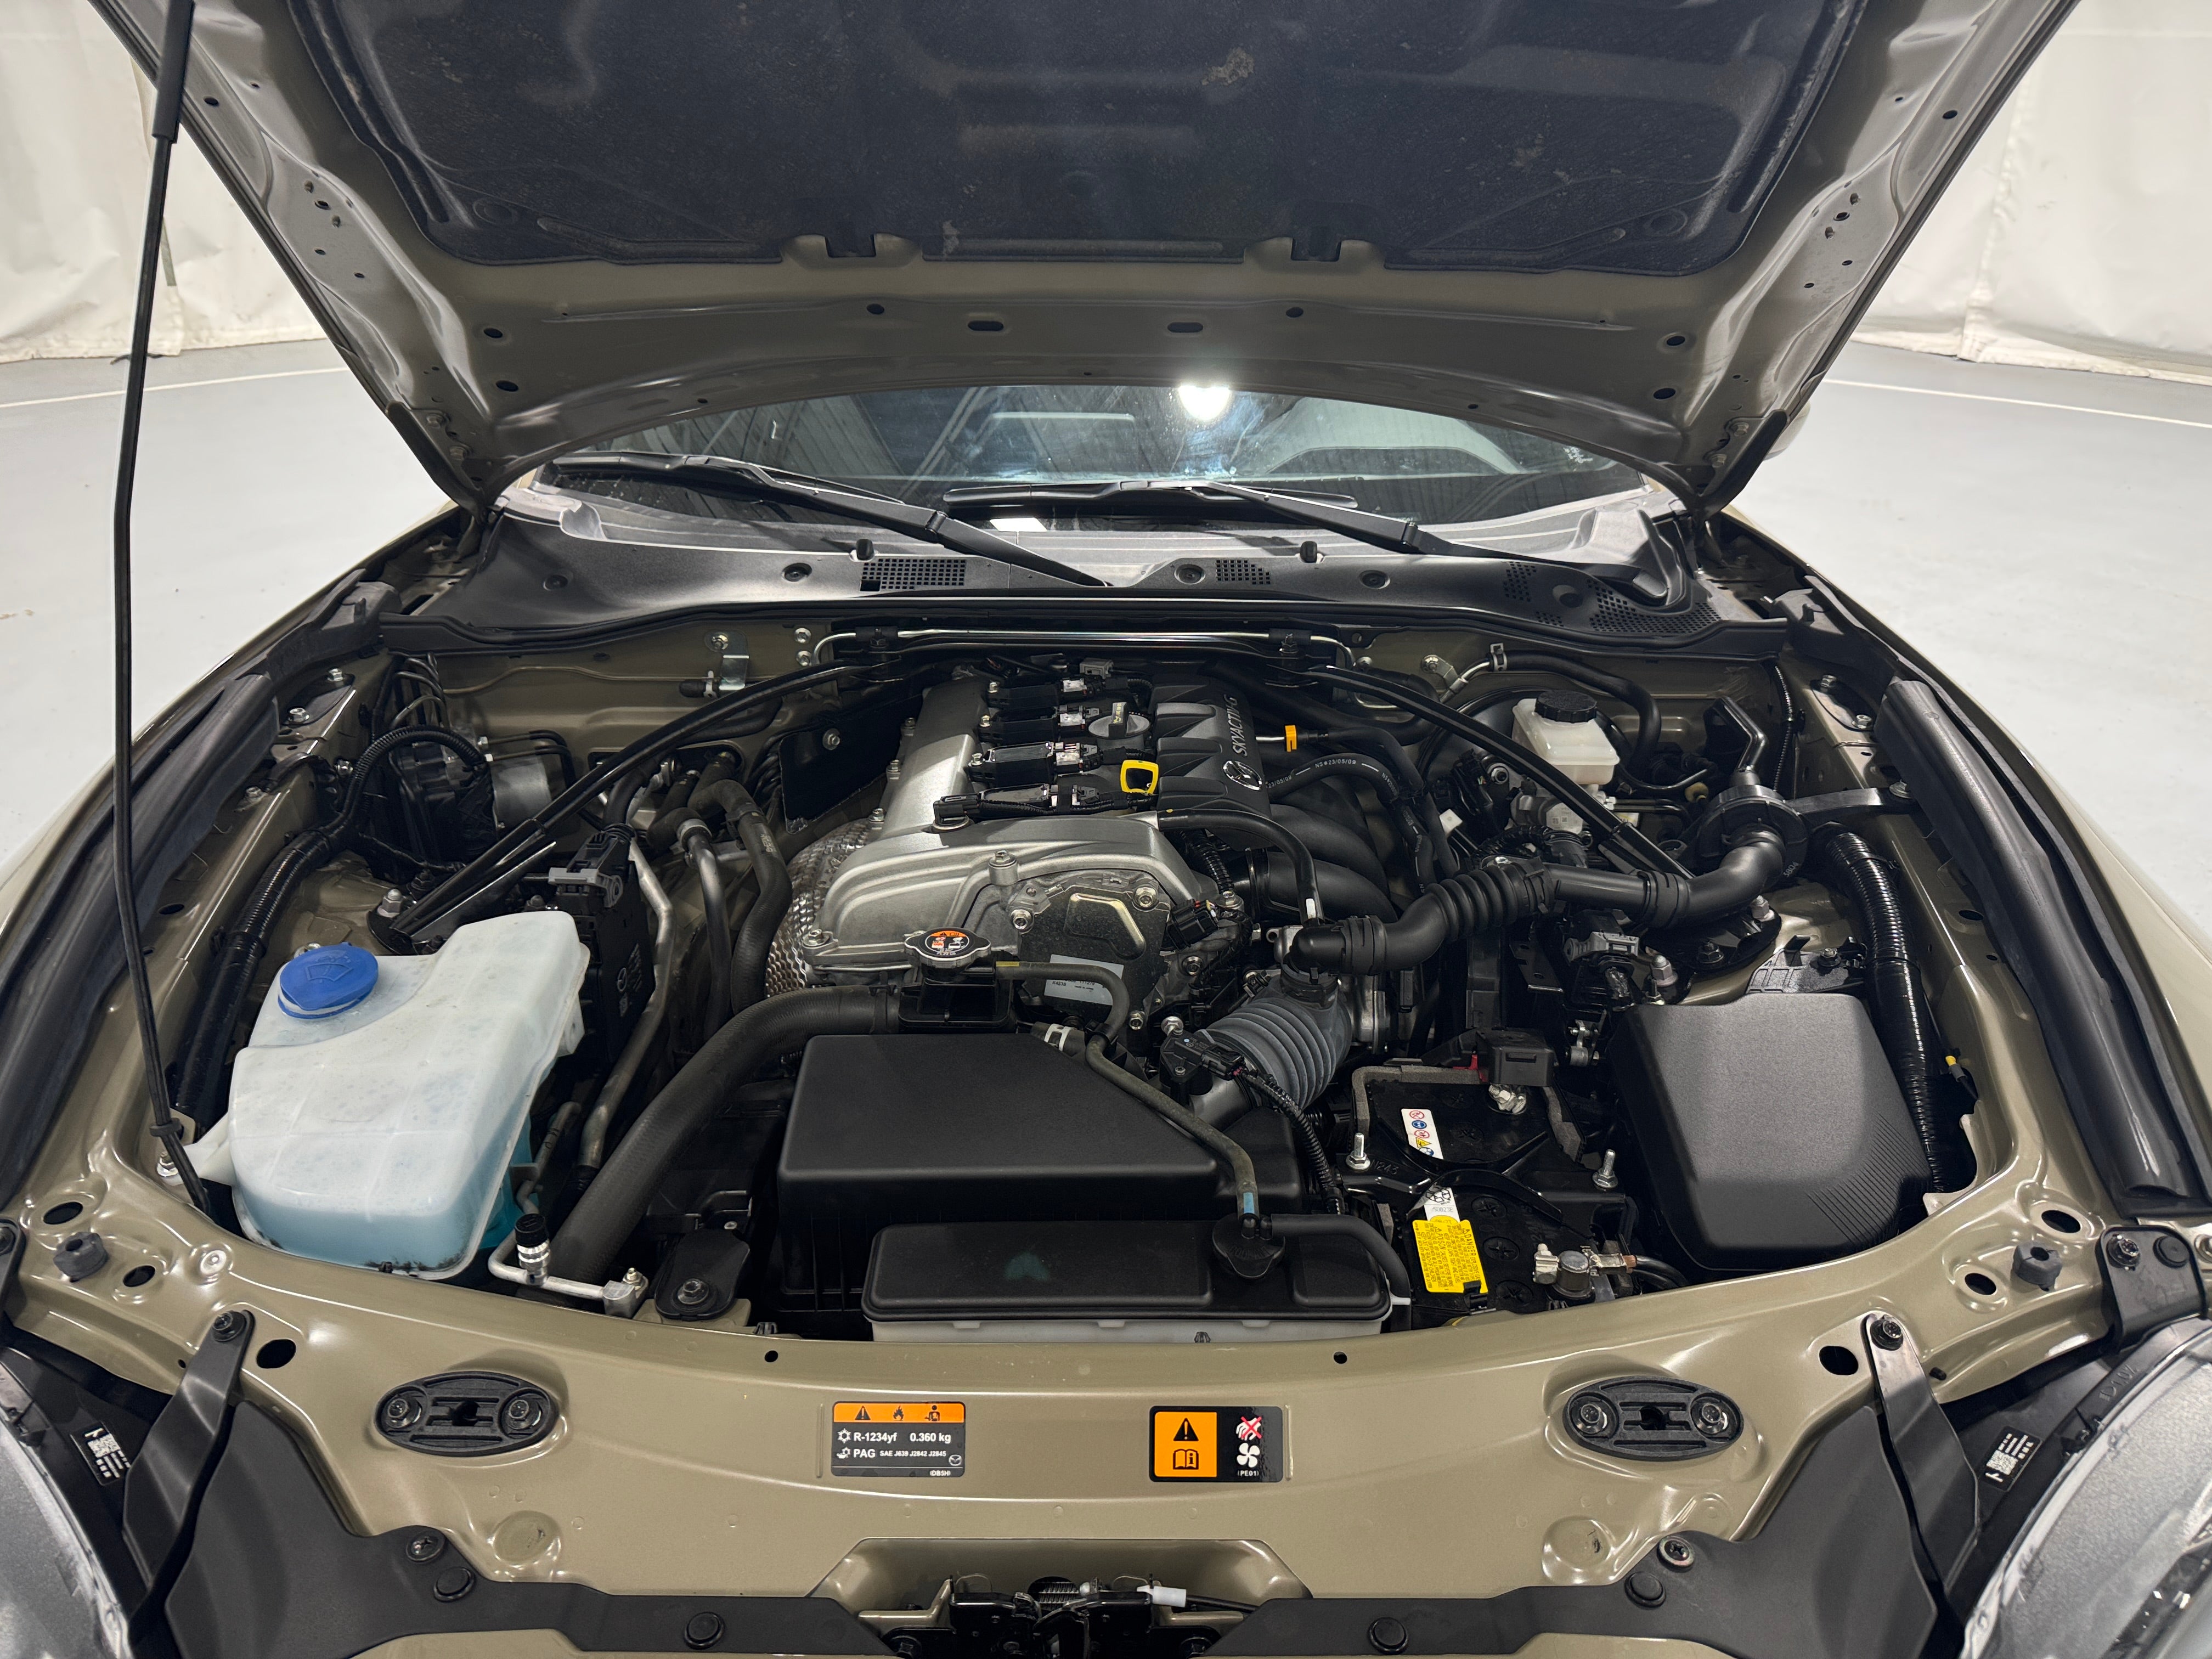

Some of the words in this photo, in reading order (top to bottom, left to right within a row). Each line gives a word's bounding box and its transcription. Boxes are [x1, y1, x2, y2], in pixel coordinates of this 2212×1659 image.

[1223, 694, 1248, 757] SKYACTIV-G
[1435, 1233, 1446, 1249] POISON
[1464, 1234, 1477, 1256] DANGER
[853, 1432, 898, 1443] R-1234yf
[910, 1432, 936, 1442] 0.360
[939, 1432, 951, 1444] kg
[853, 1449, 876, 1458] PAG
